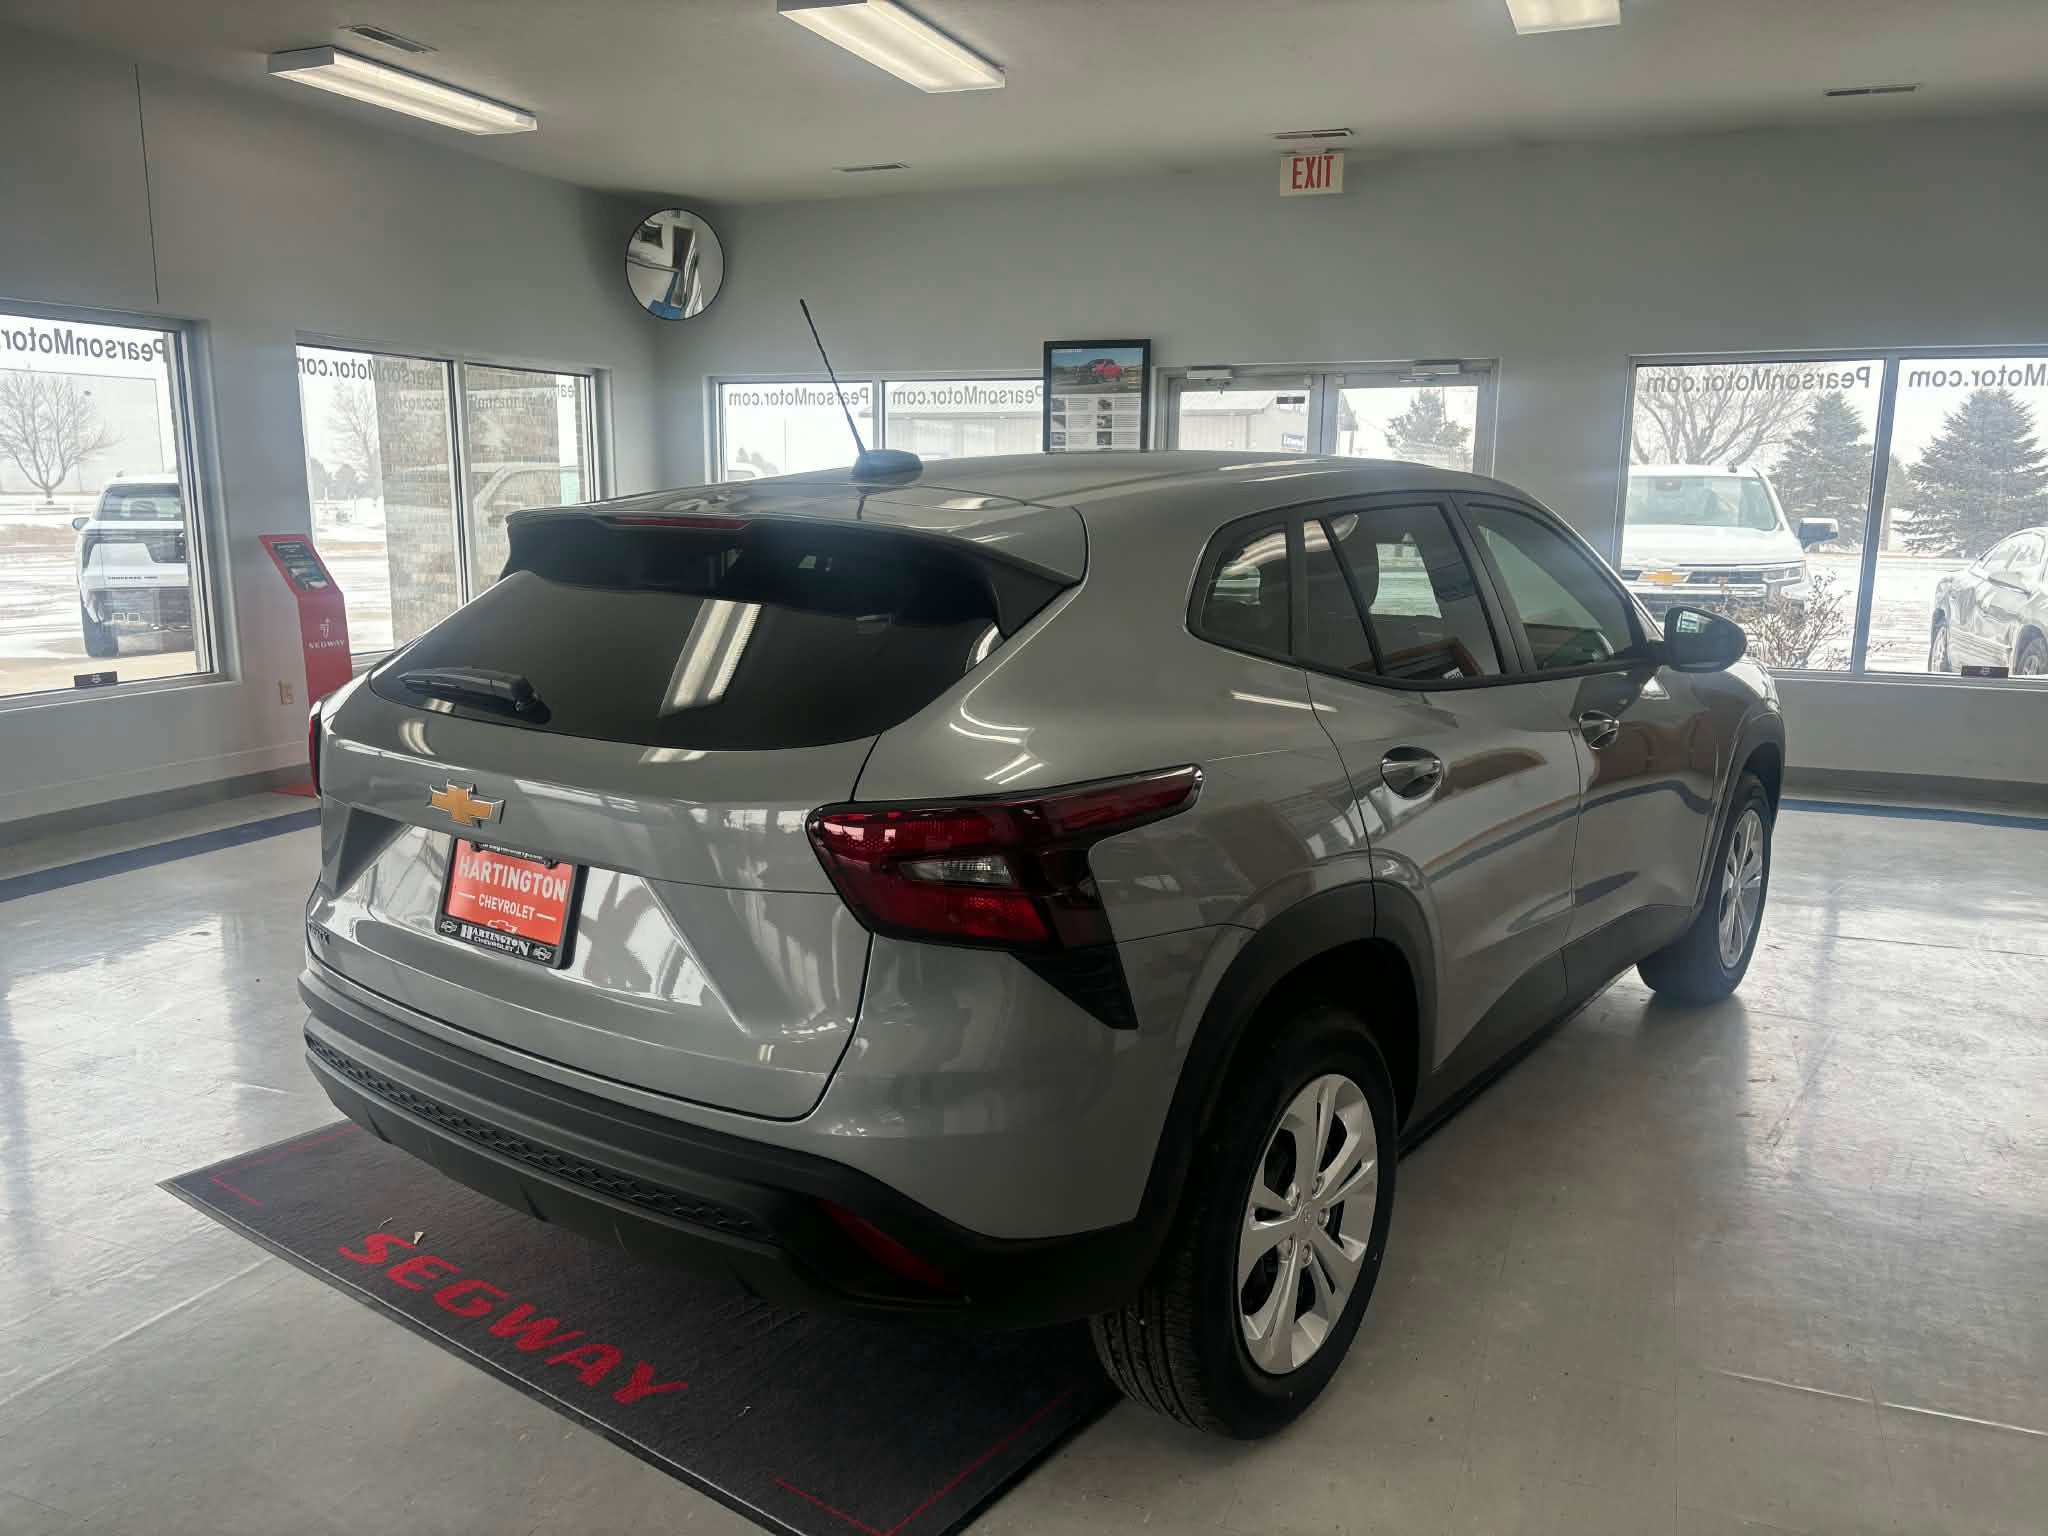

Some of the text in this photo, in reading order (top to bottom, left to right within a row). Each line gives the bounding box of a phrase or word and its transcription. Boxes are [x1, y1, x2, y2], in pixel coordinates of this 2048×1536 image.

[1292, 155, 1335, 189] EXIT
[458, 855, 567, 903] HARTINGTON
[478, 893, 536, 921] CHEVROLET
[460, 924, 530, 957] HARTINGTON
[338, 1232, 689, 1406] SEGWAY
